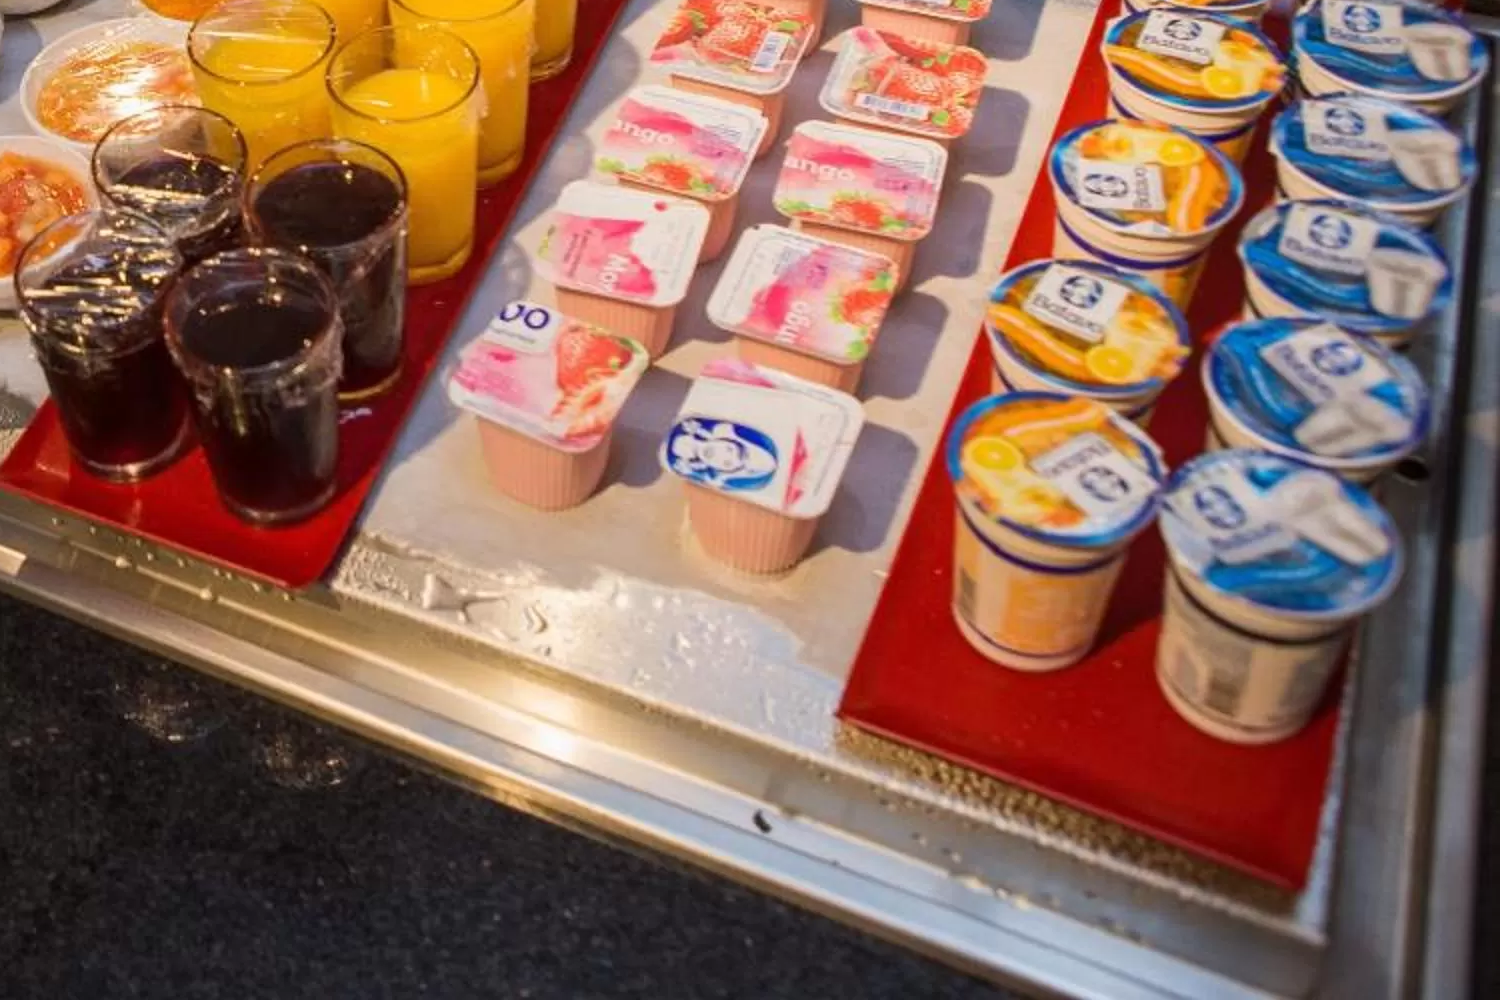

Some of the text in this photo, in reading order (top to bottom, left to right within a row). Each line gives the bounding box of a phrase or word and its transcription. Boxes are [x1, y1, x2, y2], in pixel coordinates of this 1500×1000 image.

[1142, 34, 1210, 56] Batavo
[1330, 26, 1404, 45] Batavo
[1309, 132, 1390, 152] Batavo
[1132, 166, 1153, 210] Batavo
[1283, 235, 1368, 267] Batavo
[1033, 292, 1106, 333] Batavo
